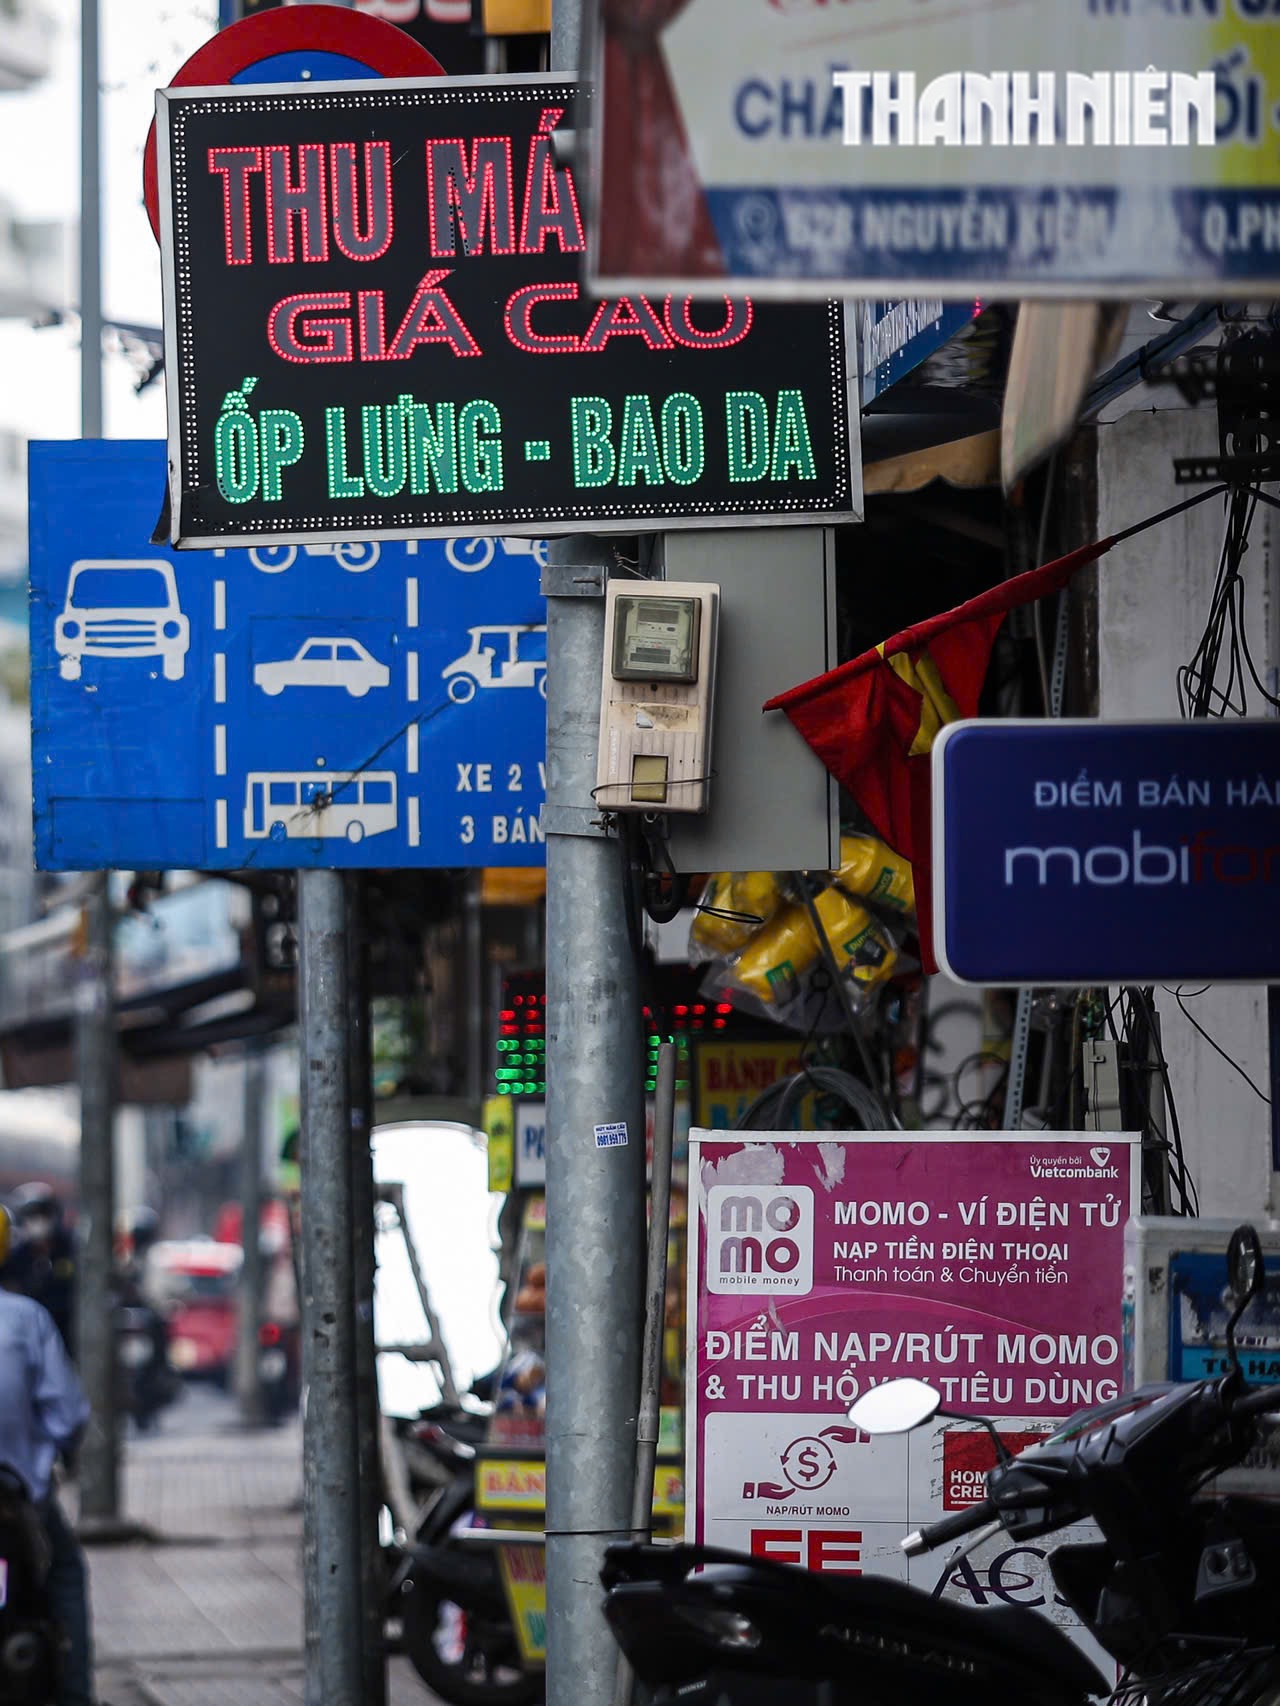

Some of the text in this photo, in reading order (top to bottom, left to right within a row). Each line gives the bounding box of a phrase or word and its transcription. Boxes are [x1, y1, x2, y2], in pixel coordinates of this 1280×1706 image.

[207, 140, 394, 267] THU
[267, 269, 754, 363] GIÁ CAO
[214, 376, 306, 504] ỐP
[325, 393, 504, 499] LƯNG
[570, 391, 706, 489] BAO
[725, 389, 818, 482] DA
[456, 763, 492, 792] XE
[507, 763, 522, 791] 2
[1034, 768, 1280, 807] ĐIỂM BÁN HÀ
[460, 815, 475, 844] 3
[1030, 1165, 1119, 1178] Vietcombank
[834, 1201, 930, 1226] MOMO
[958, 1196, 989, 1226] VÍ
[996, 1196, 1069, 1231] ĐIỆN
[1079, 1193, 1122, 1227] TỬ
[833, 1234, 1069, 1265] NẠP TIỀN ĐIỆN THOẠI
[720, 1275, 800, 1286] mobile money
[834, 1263, 1069, 1287] Thanh toán & Chuyển tiền
[705, 1315, 1119, 1368] ĐIỂM NẠP/RÚT MOMO
[704, 1375, 726, 1400] &
[737, 1375, 801, 1401] THU
[813, 1369, 859, 1406] HỘ
[940, 1371, 1013, 1403] TIÊU
[1025, 1371, 1118, 1404] DÙNG
[766, 1504, 850, 1517] NẠP/RÚT MOMO
[751, 1529, 862, 1577] FE
[930, 1545, 1073, 1607] AC
